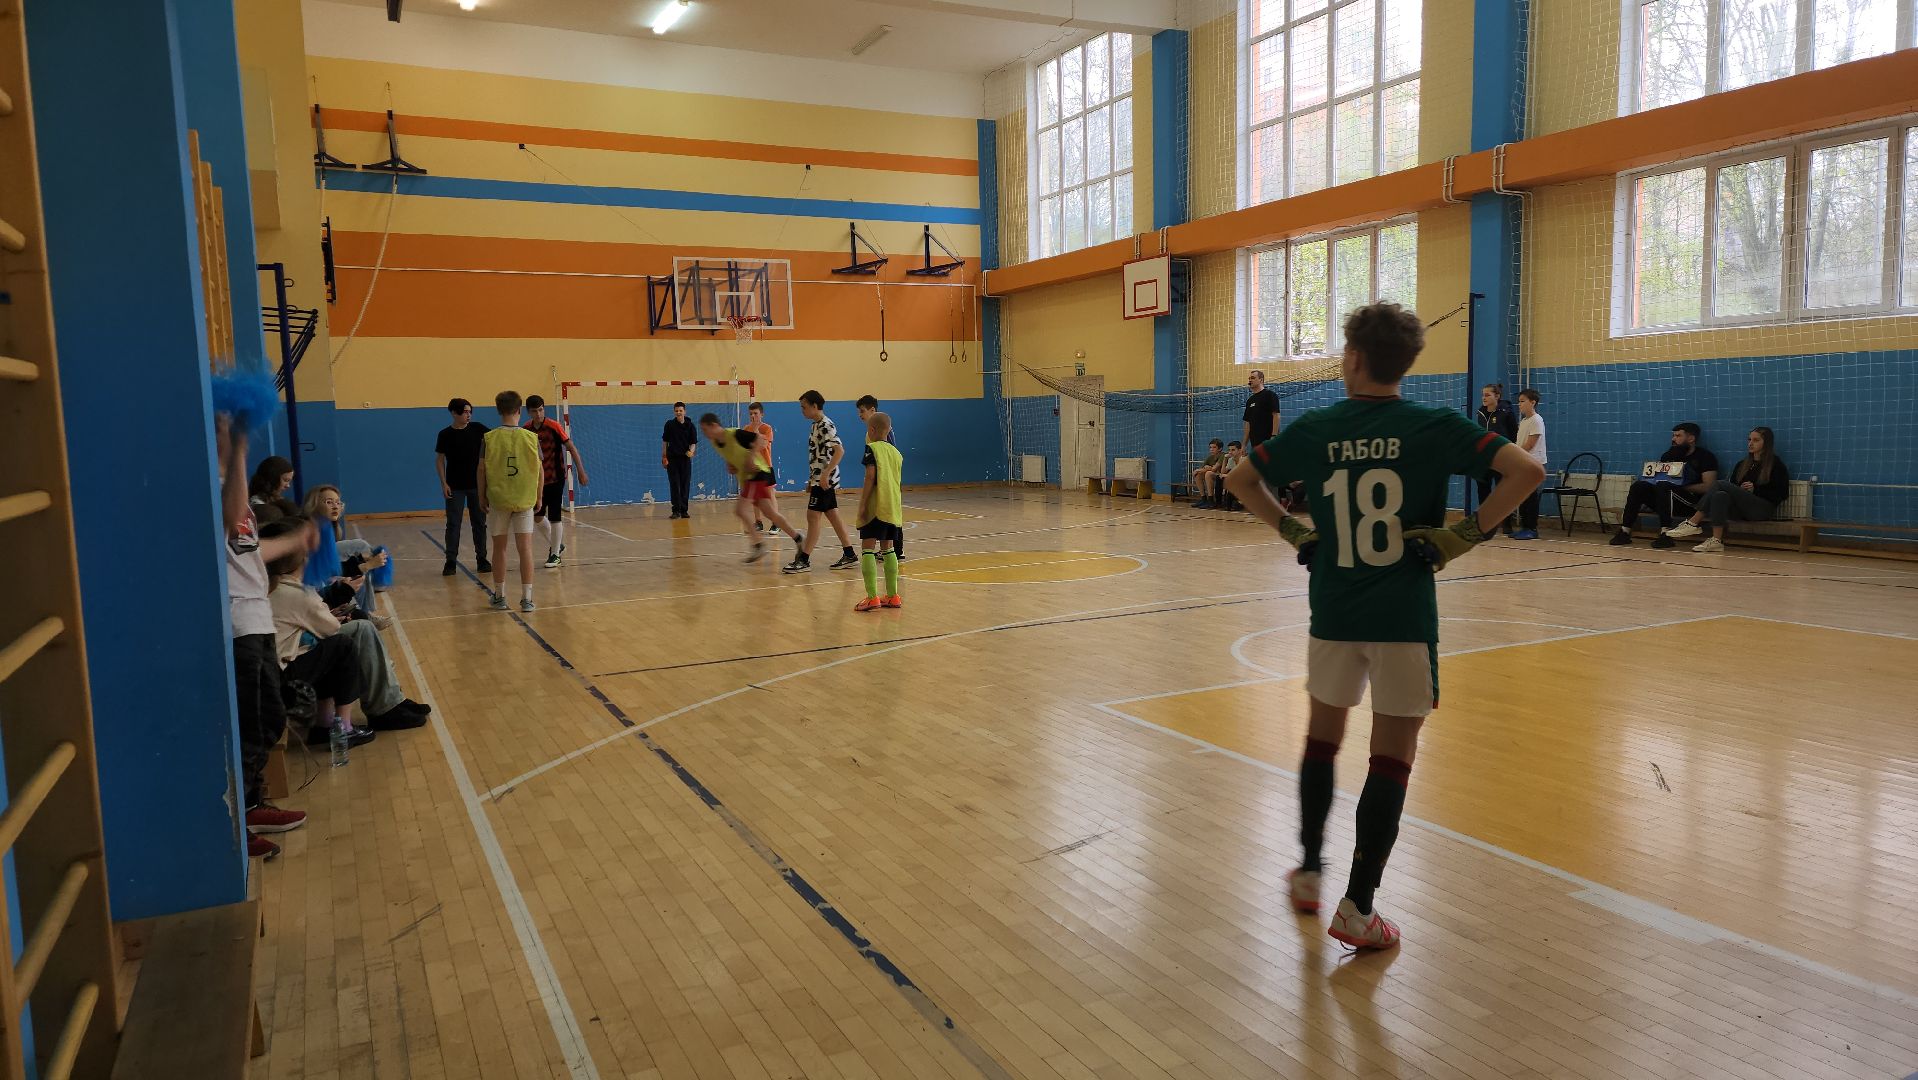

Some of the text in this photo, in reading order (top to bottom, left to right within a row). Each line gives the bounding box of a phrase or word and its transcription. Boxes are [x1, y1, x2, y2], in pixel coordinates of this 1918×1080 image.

[1327, 438, 1400, 462] ГАБОВ
[507, 456, 518, 476] 5
[1646, 465, 1653, 475] 3
[1323, 468, 1404, 567] 18
